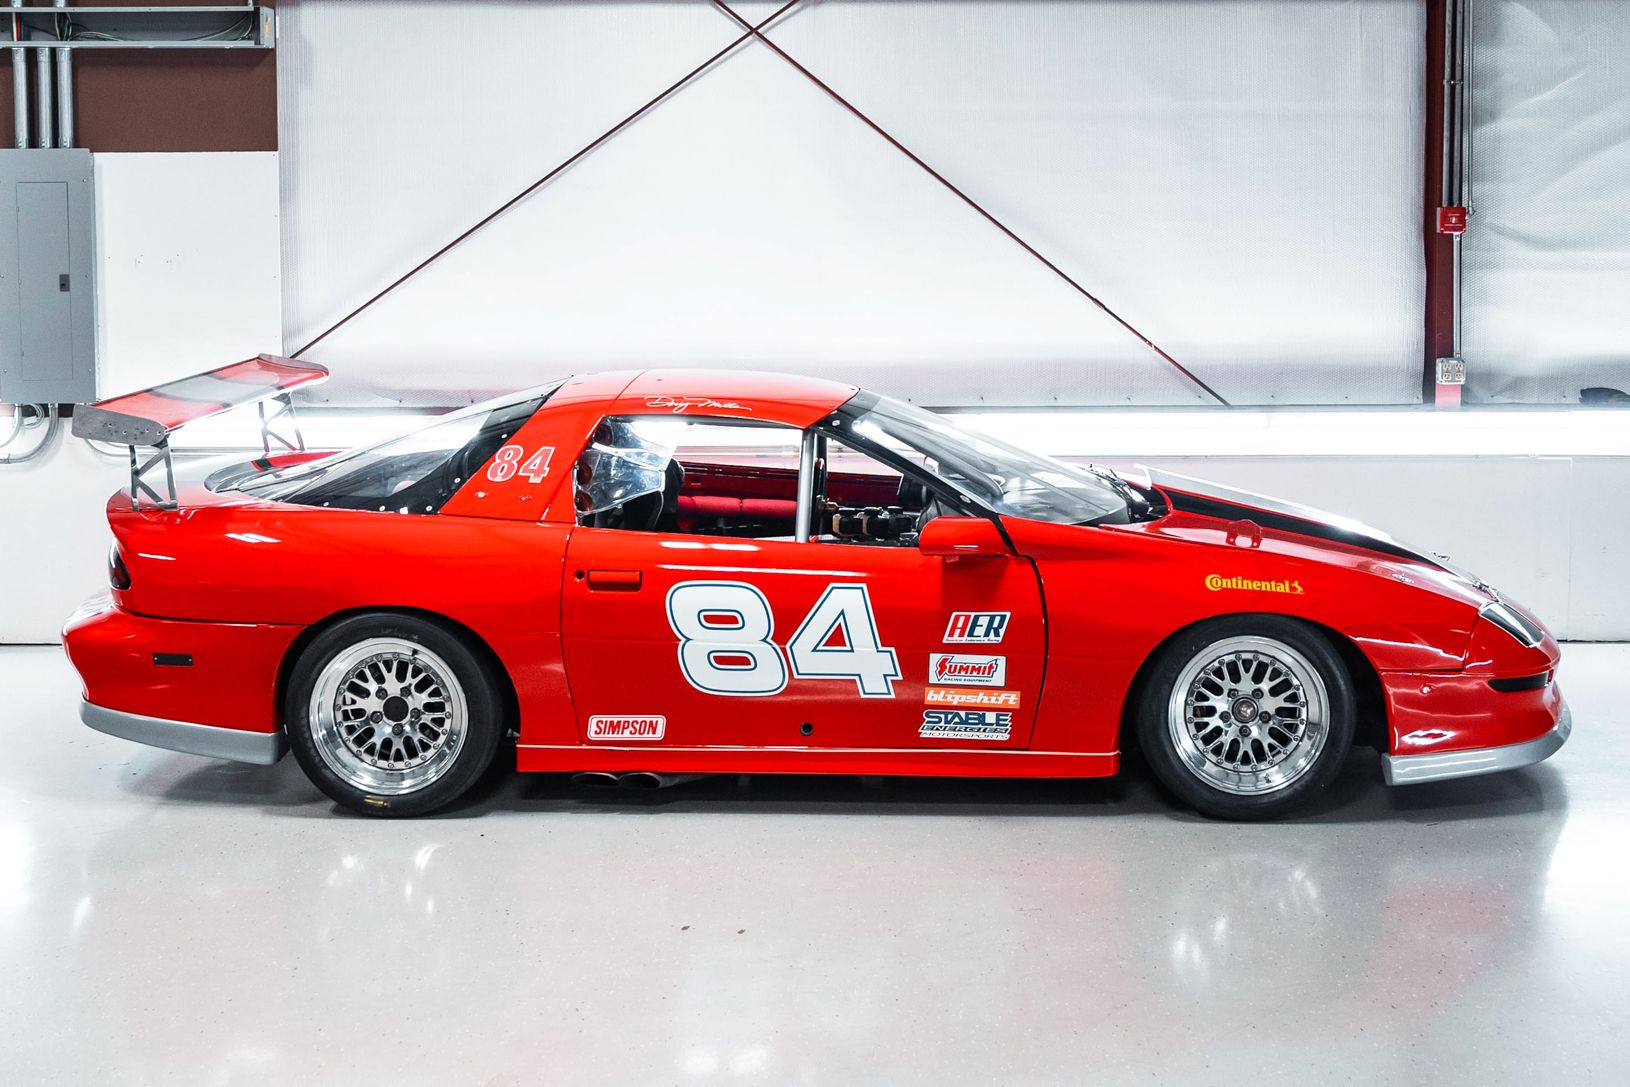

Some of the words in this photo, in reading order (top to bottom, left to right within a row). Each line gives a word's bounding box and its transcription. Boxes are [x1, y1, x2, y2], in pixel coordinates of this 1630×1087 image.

[487, 444, 556, 484] 84
[1205, 573, 1291, 593] Continental
[948, 614, 1008, 638] AER
[665, 580, 903, 698] 84
[926, 689, 1019, 705] blipshift
[594, 719, 658, 735] SIMPSON
[924, 710, 1010, 727] STABLE
[922, 725, 1008, 733] ENERGIES
[922, 732, 1008, 740] MOTORSPORTS
